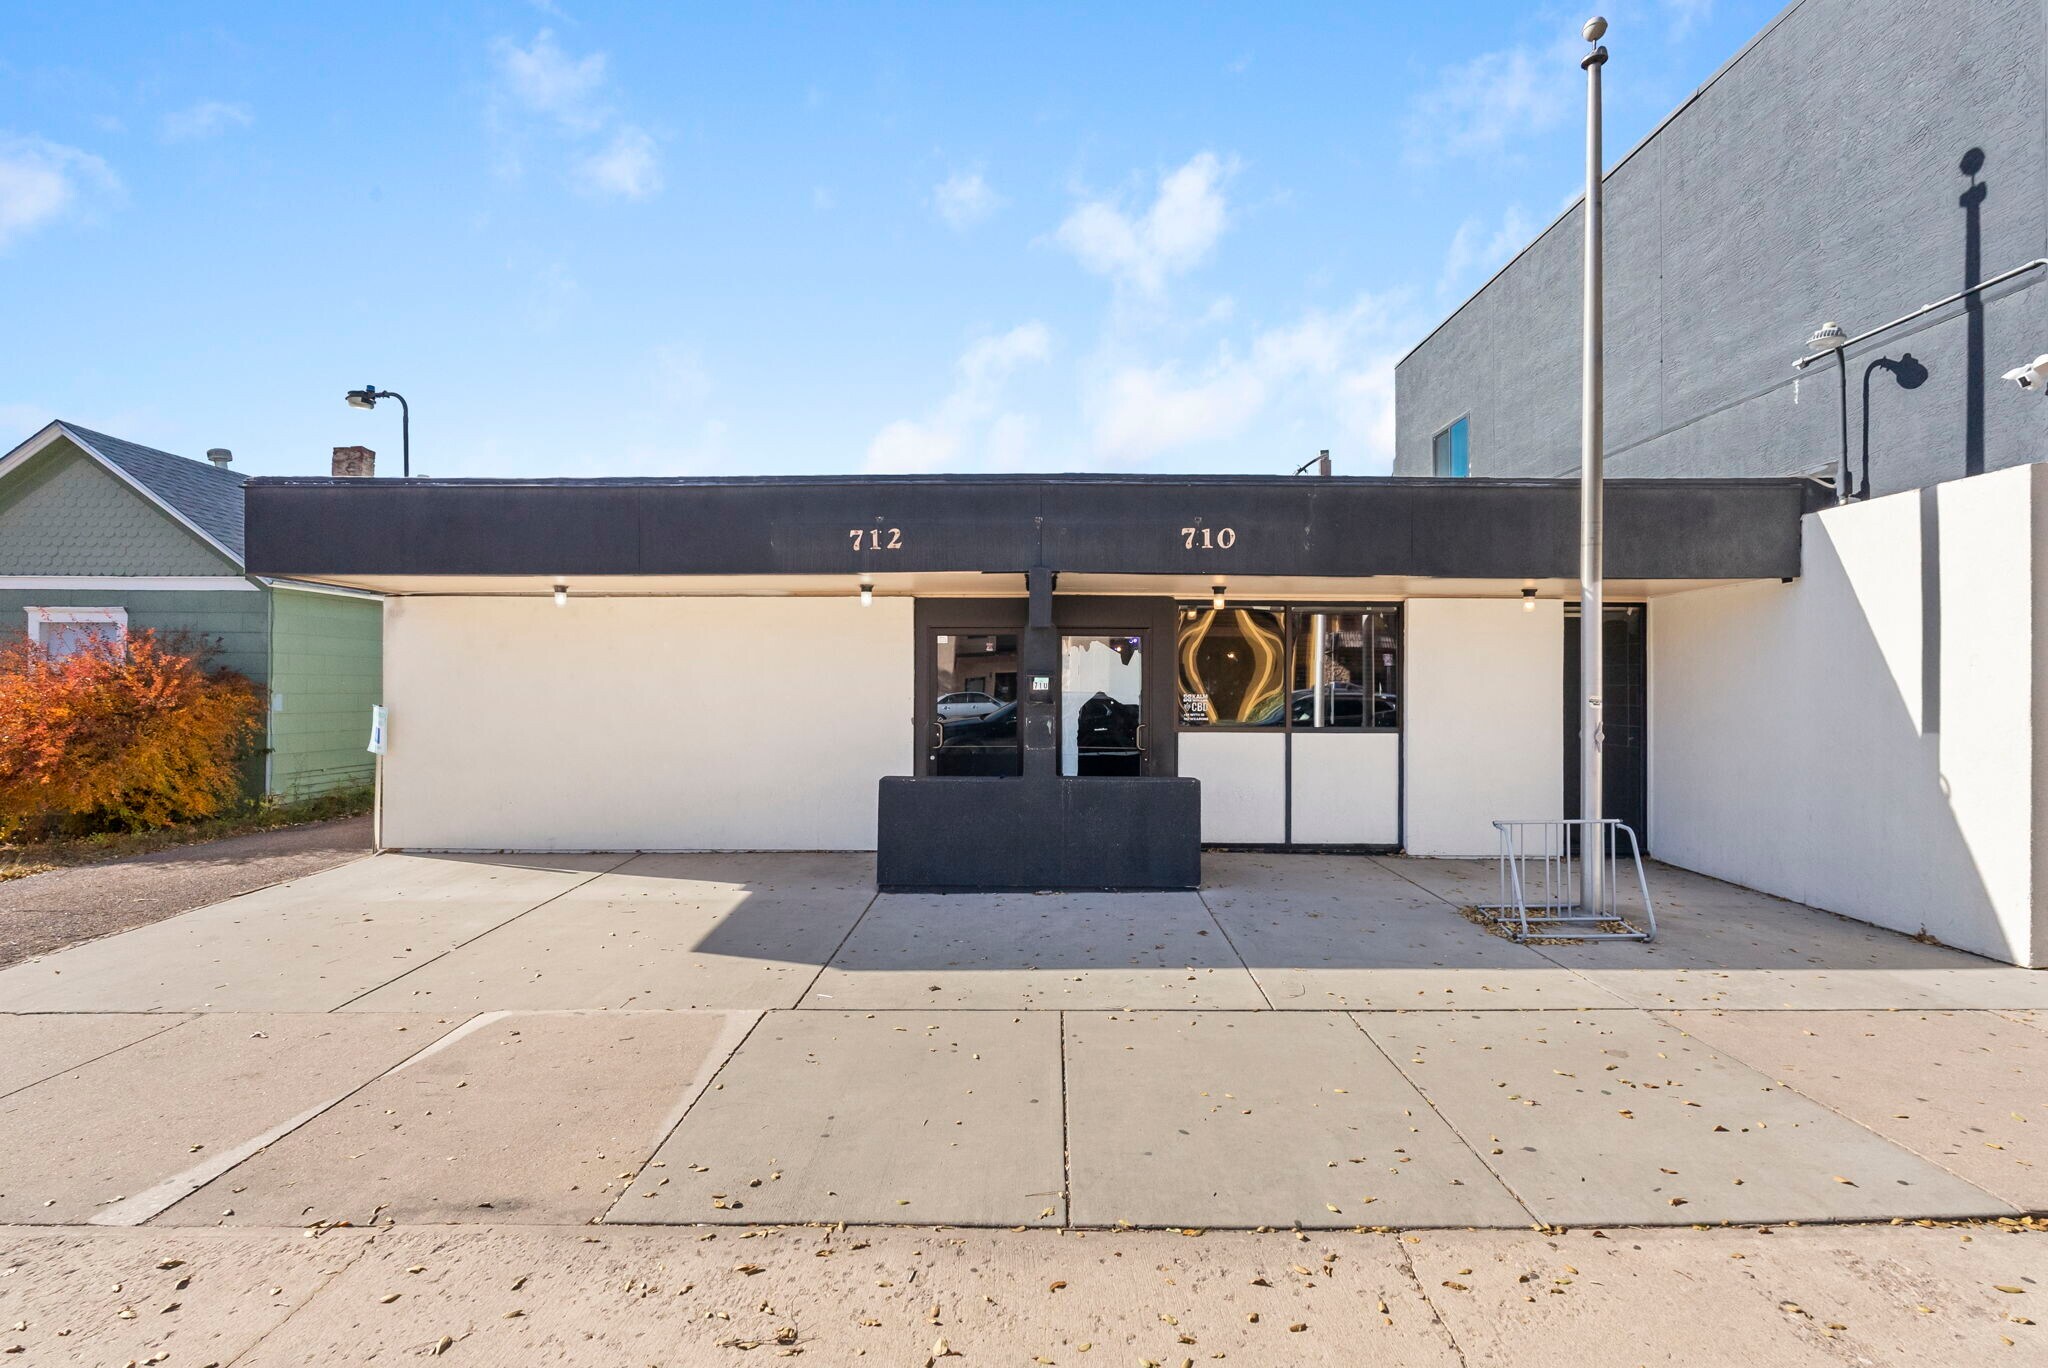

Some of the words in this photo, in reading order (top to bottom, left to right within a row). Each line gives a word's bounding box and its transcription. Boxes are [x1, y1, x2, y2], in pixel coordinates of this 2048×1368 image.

[850, 528, 903, 551] 712
[1181, 527, 1236, 550] 710
[1191, 702, 1208, 711] CBD
